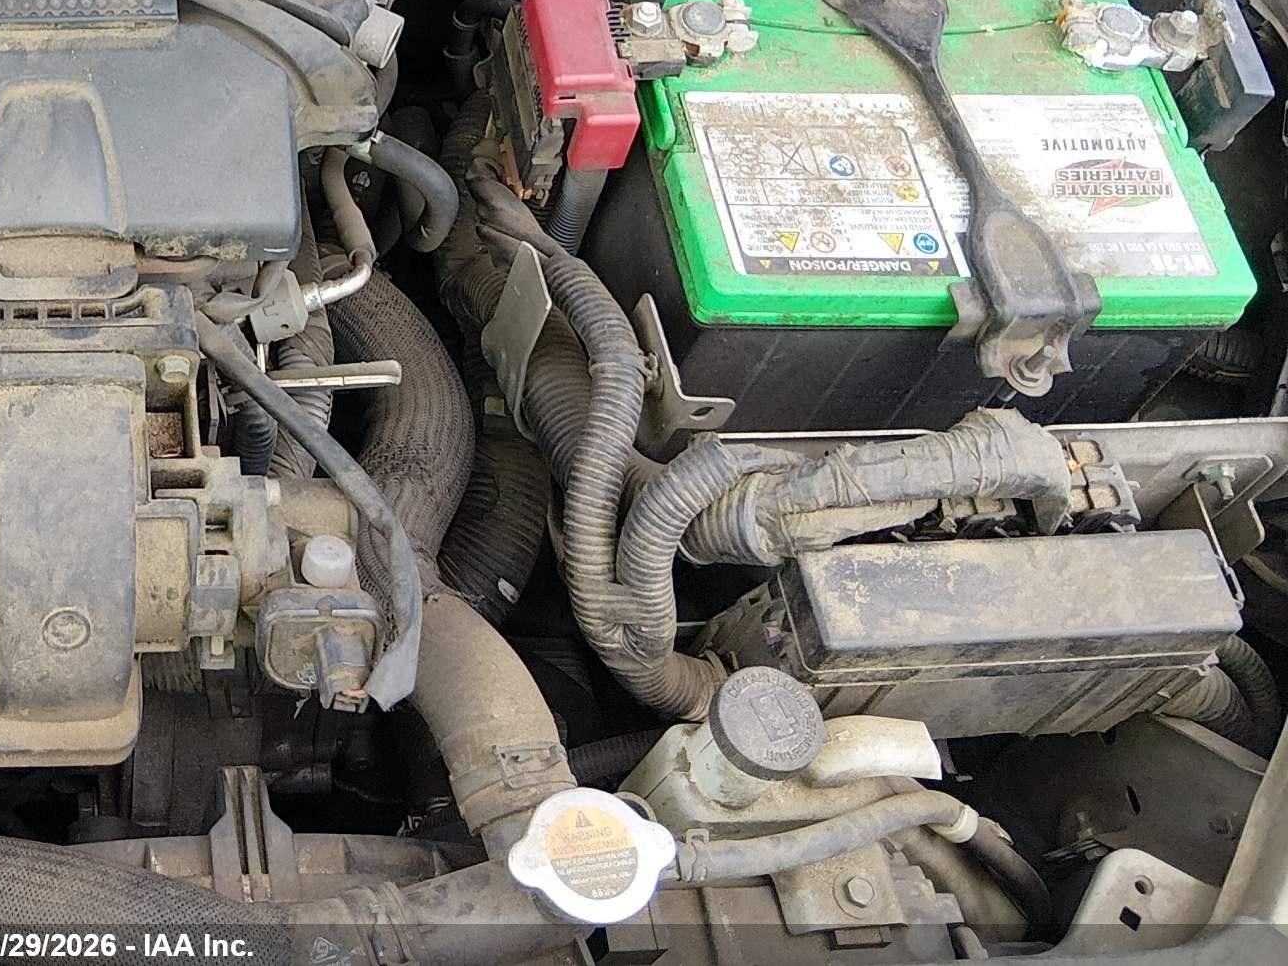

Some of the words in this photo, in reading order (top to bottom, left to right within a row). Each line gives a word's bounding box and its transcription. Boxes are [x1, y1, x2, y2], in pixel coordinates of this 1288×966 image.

[1040, 138, 1147, 152] AUTOMOTIVE
[1056, 170, 1160, 182] BATTERIES
[1053, 184, 1172, 197] INTERSTATE
[789, 258, 912, 272] DANGER/POISON
[562, 826, 612, 844] WARNING
